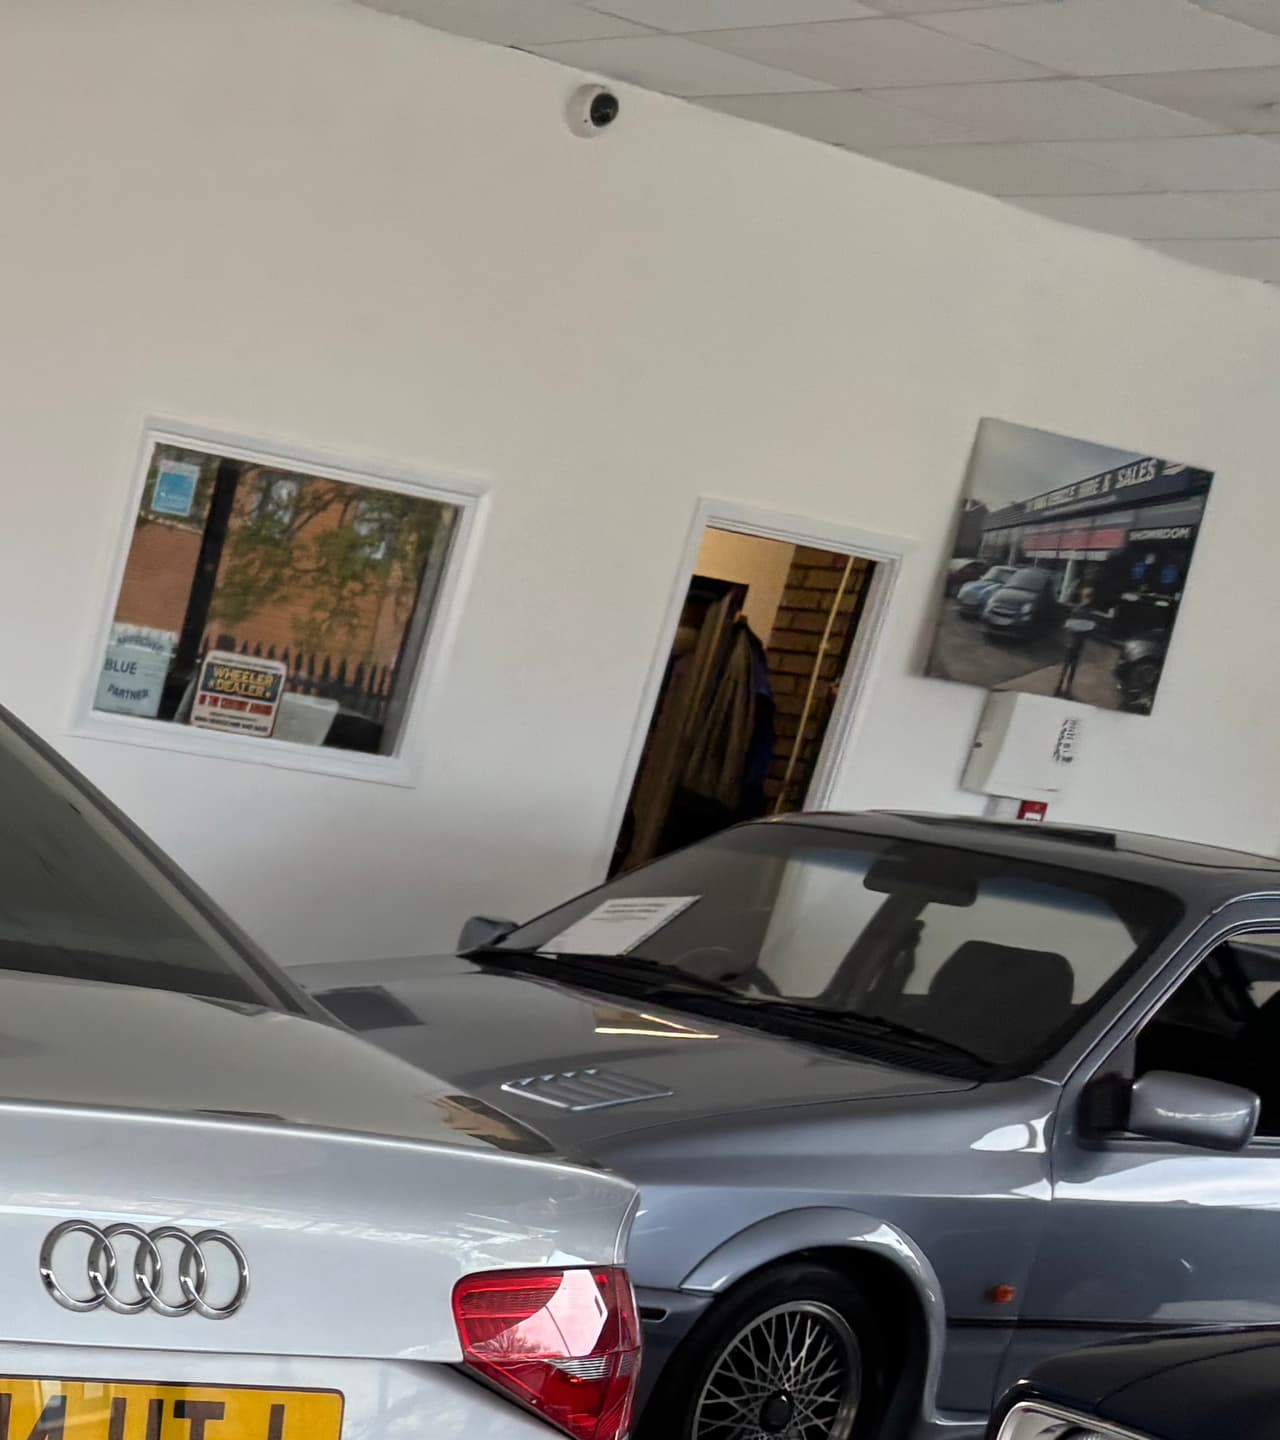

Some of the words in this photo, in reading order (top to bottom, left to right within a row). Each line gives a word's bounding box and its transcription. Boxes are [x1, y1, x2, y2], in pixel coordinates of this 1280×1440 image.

[104, 657, 137, 676] BLUE
[213, 665, 274, 687] WHEELER
[107, 683, 149, 700] PARTNER
[216, 679, 267, 698] DEALER
